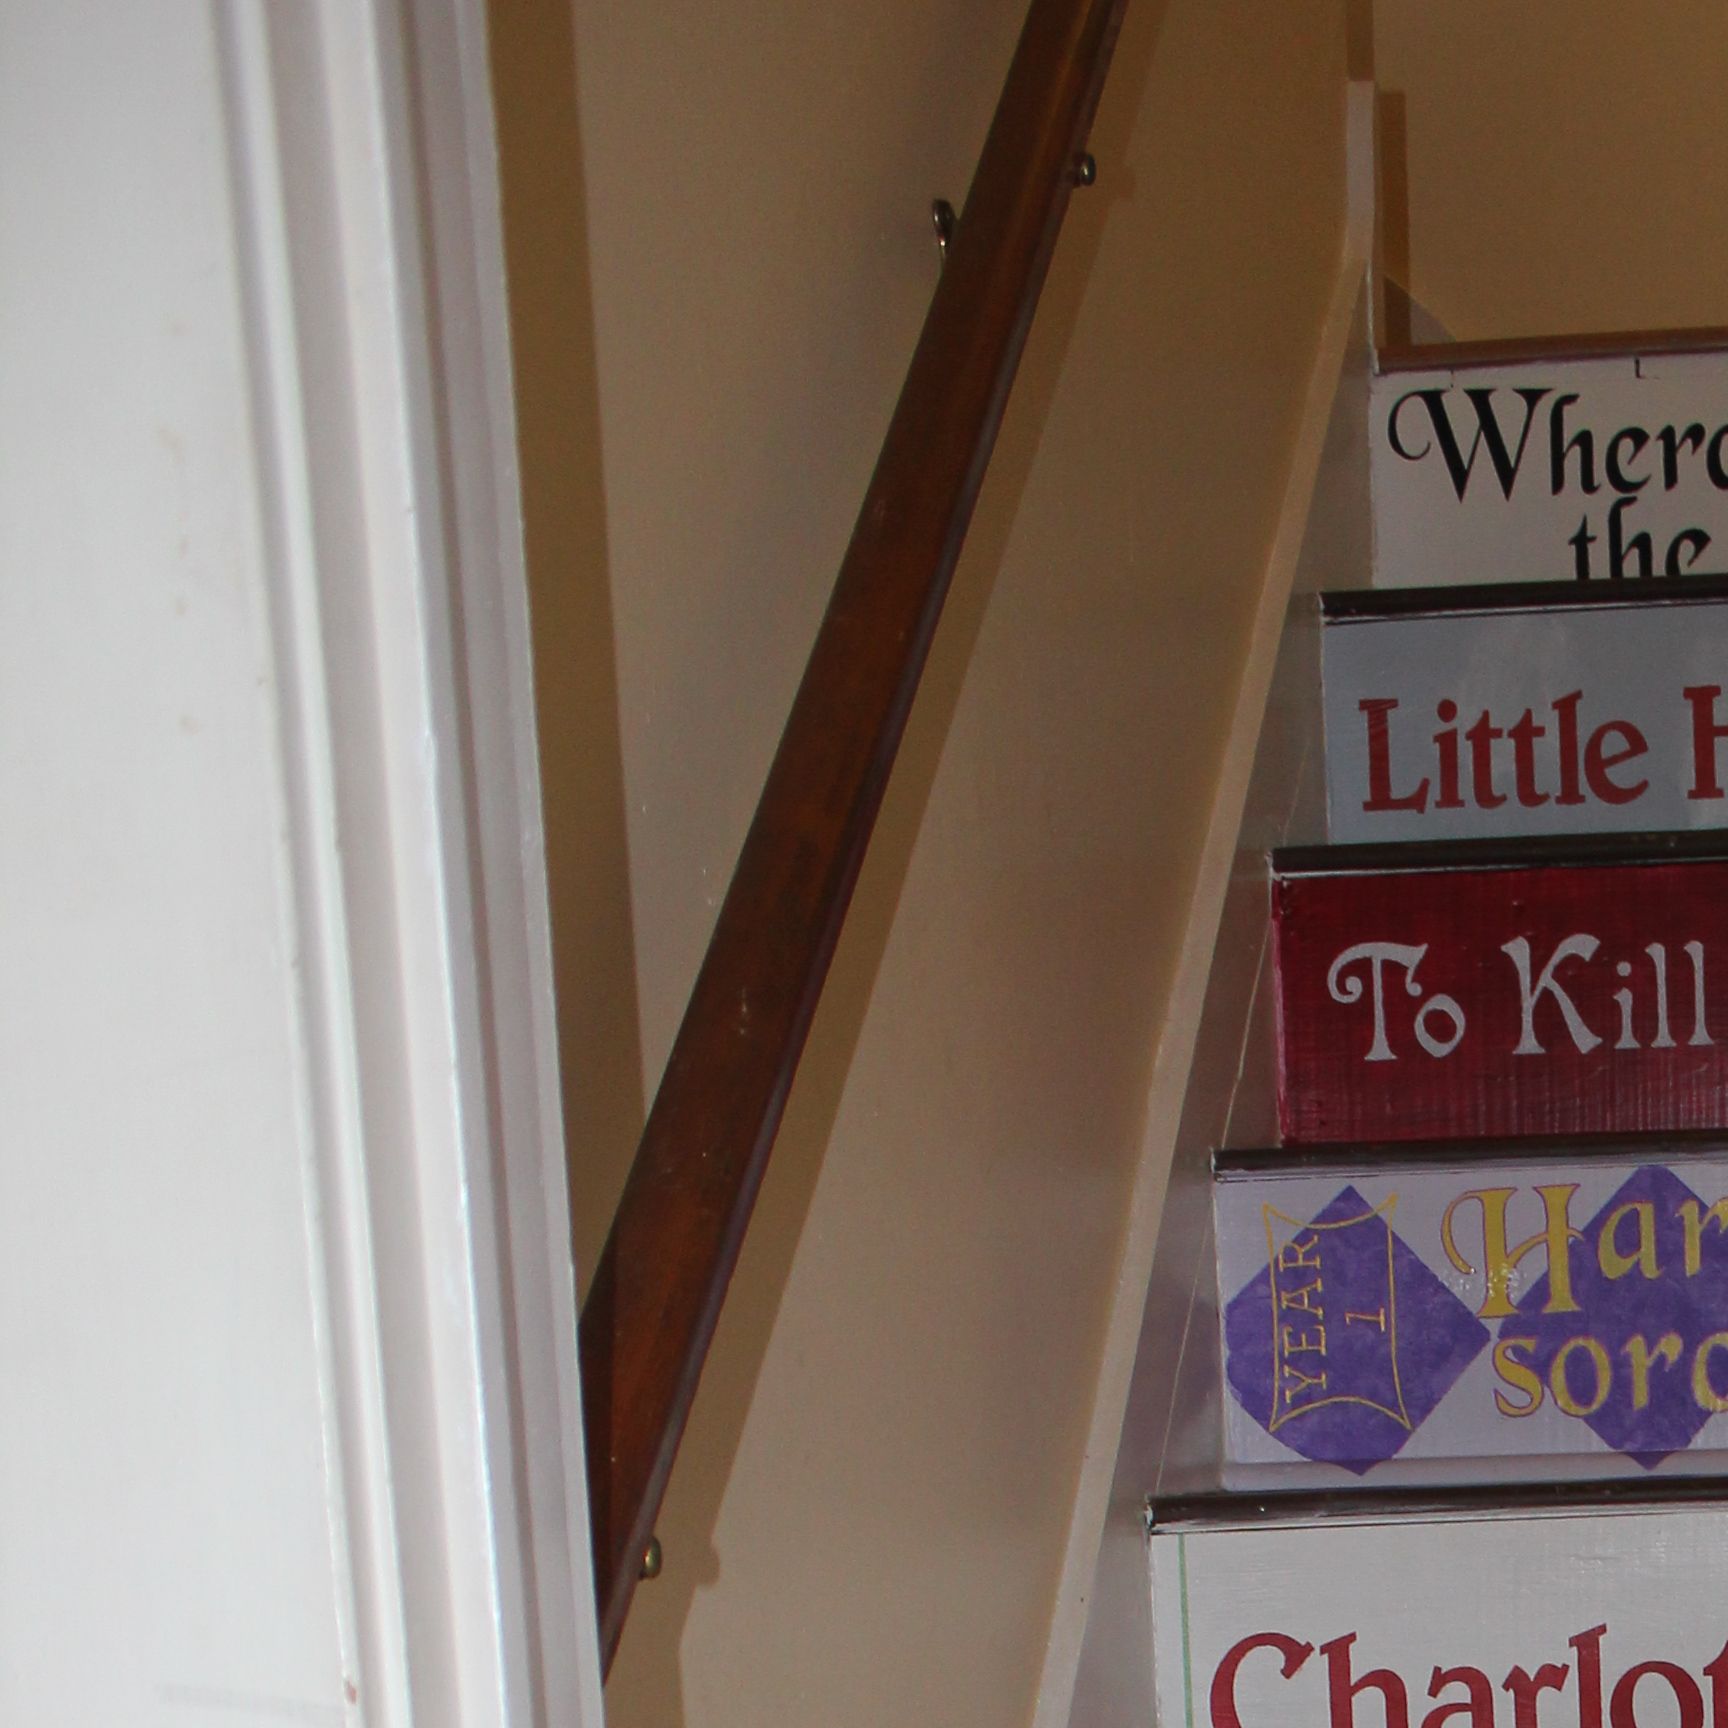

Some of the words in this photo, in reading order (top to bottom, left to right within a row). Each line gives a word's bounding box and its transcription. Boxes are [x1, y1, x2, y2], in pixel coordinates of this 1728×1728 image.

[1569, 495, 1711, 580] the
[1358, 689, 1649, 814] Little
[1326, 941, 1468, 1062] To
[1500, 932, 1717, 1057] Kill
[1282, 1231, 1330, 1404] YEAR
